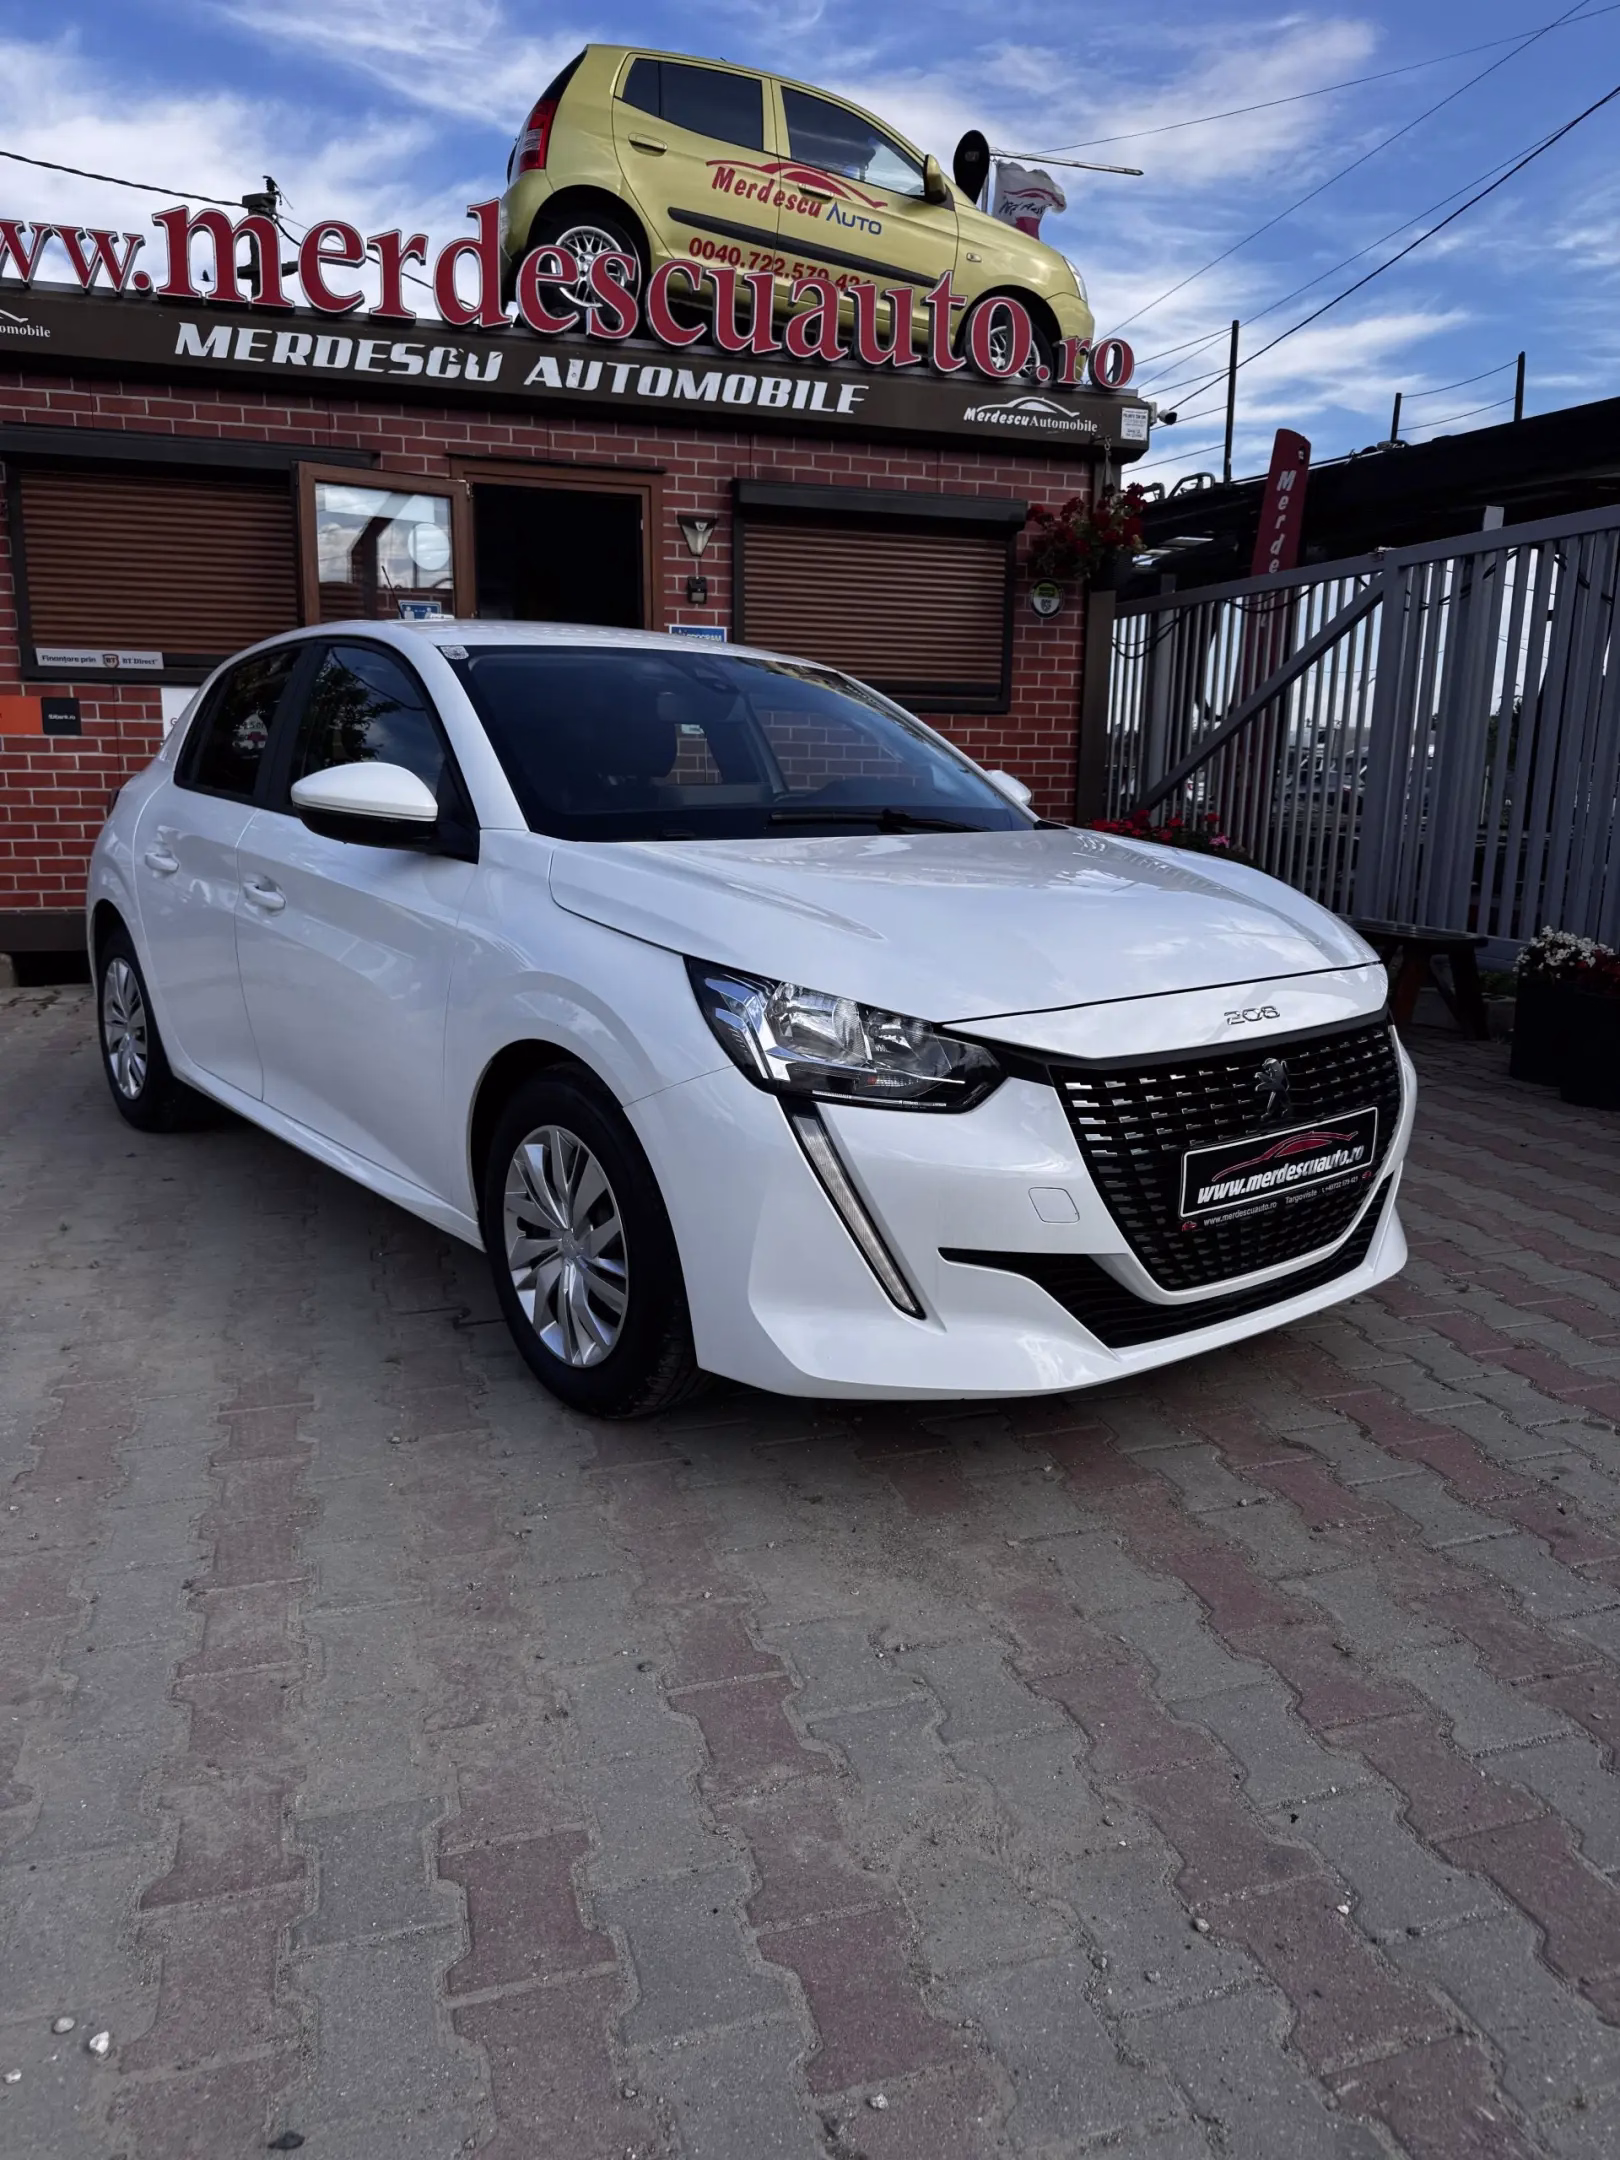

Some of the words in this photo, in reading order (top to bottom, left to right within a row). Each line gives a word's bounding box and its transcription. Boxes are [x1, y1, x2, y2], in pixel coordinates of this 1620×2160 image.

[711, 166, 823, 219] Merdescu
[826, 202, 883, 235] AUTO
[174, 322, 503, 382] MERDESCU
[524, 355, 870, 414] AUTOMOBILE
[1268, 470, 1297, 574] Merde
[80, 656, 96, 664] prin
[1224, 1005, 1280, 1025] 208
[1197, 1145, 1365, 1204] www.merdescuauto.ro
[1203, 1201, 1278, 1227] www.merdescuauto.ro
